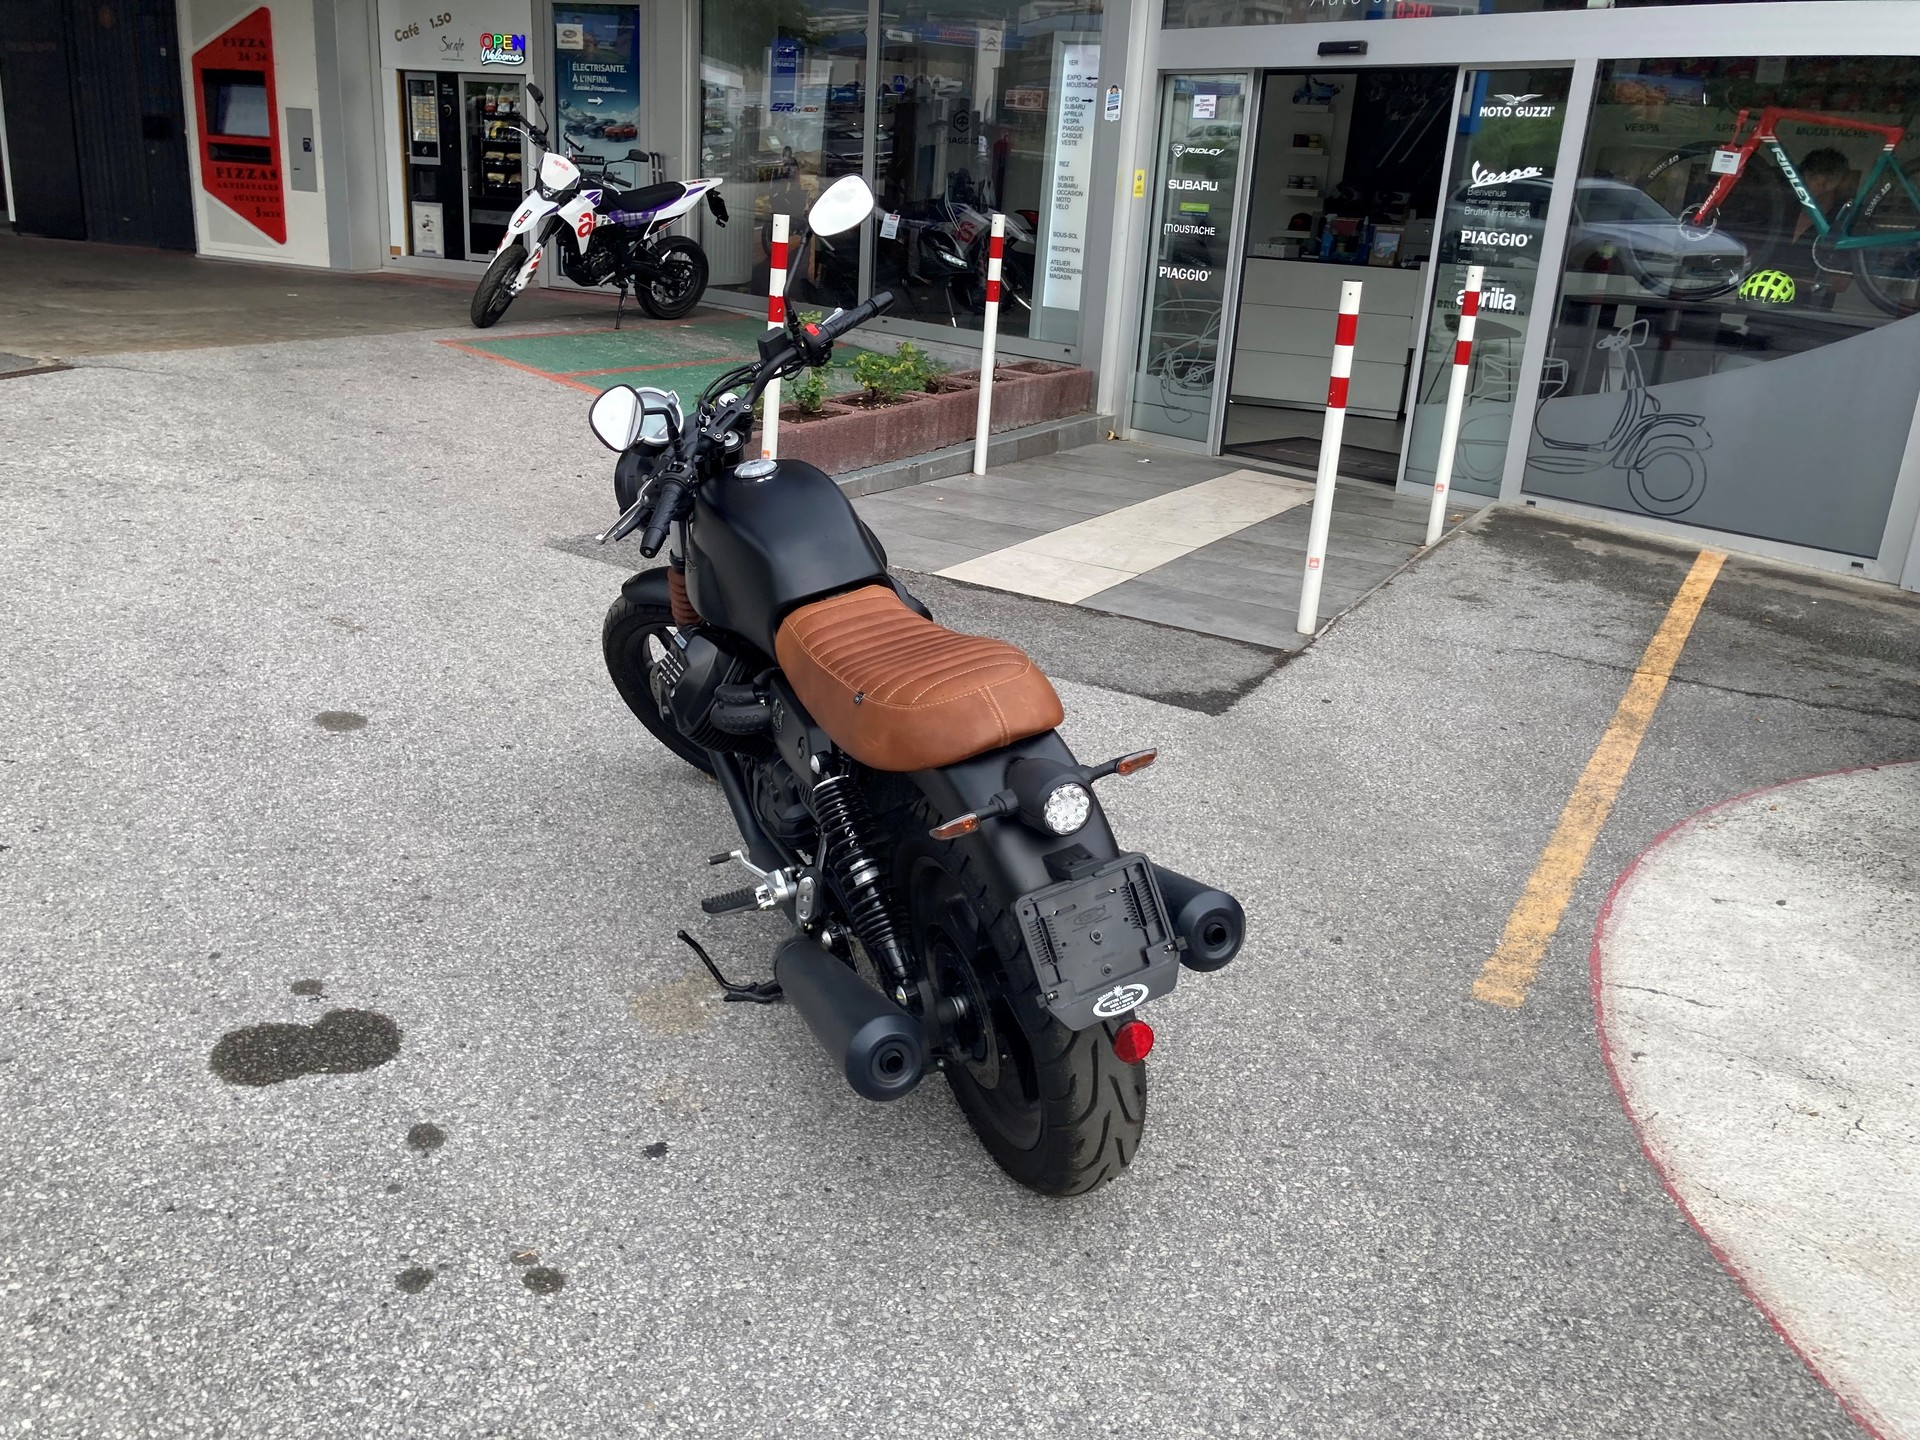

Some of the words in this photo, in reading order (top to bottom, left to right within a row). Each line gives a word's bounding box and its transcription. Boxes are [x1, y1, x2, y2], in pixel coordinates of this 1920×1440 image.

[429, 12, 452, 29] 1.50
[394, 22, 420, 42] Café
[222, 37, 267, 48] PIZZA
[480, 33, 526, 50] OPEN
[481, 47, 524, 65] Welcome
[1480, 106, 1512, 117] MOTO
[1515, 106, 1552, 117] GUZZI
[1624, 123, 1660, 133] VESPA
[1185, 147, 1225, 157] RIDLEY
[215, 167, 278, 180] PIZZAS
[1469, 160, 1543, 188] Vespa
[1771, 147, 1816, 209] RIDLEY
[1168, 180, 1219, 191] SUBARU
[1467, 187, 1507, 197] Bienvenue
[1057, 189, 1083, 197] OCCASION
[1492, 207, 1517, 218] Frères
[1519, 209, 1531, 219] SA
[1164, 223, 1216, 236] MOUSTACHE
[1461, 230, 1528, 247] PIAGGIO
[1050, 259, 1071, 267] ATELIER
[1049, 273, 1072, 281] MAGASIN
[1159, 266, 1209, 282] PIAGGIO
[1456, 287, 1517, 311] arilia
